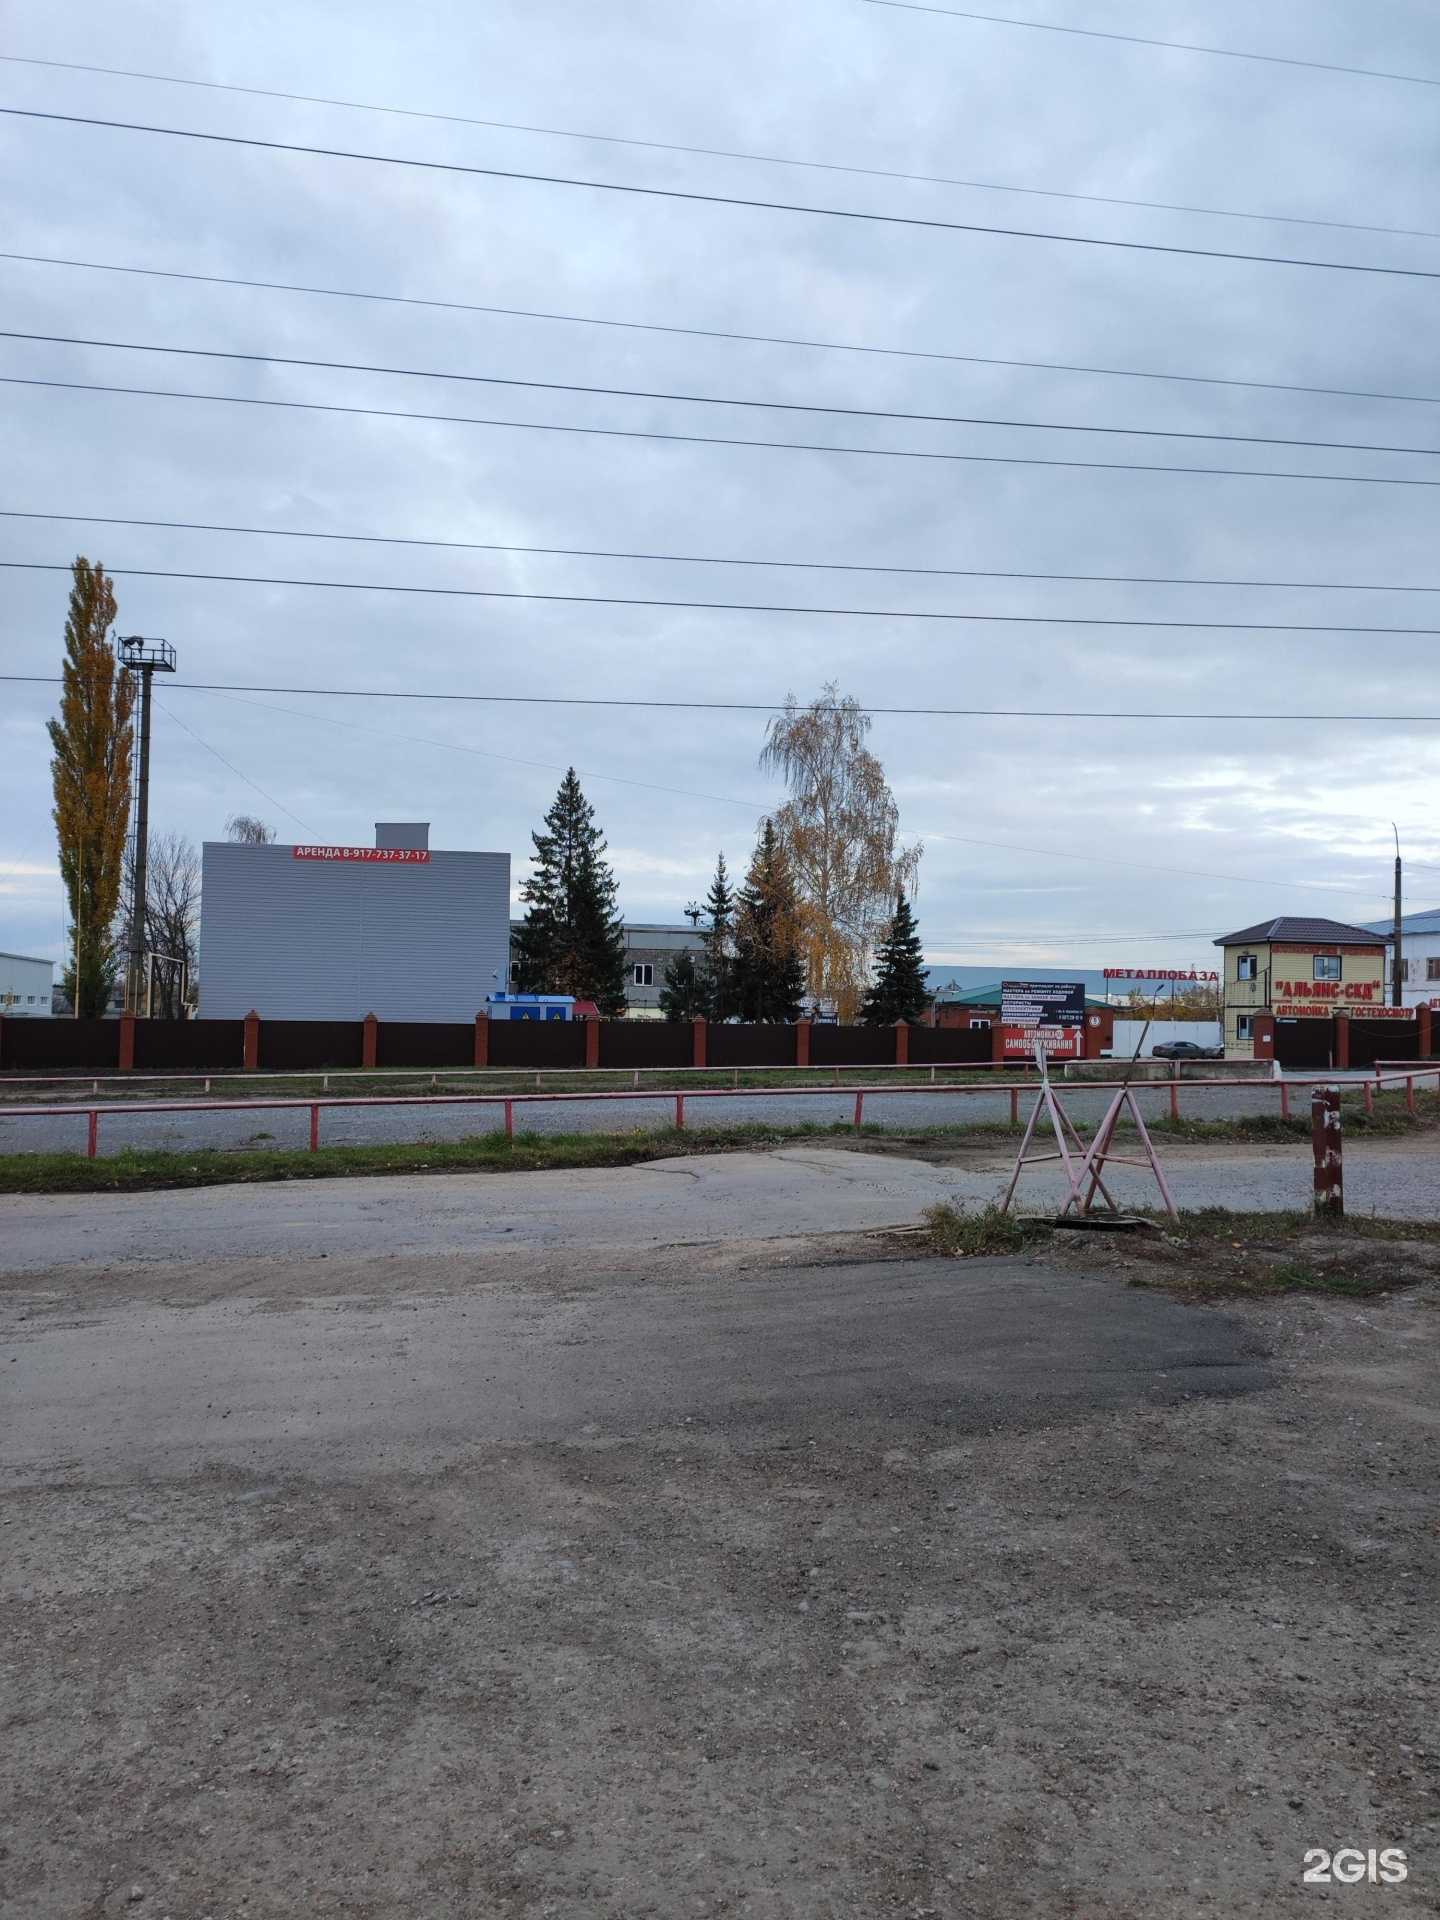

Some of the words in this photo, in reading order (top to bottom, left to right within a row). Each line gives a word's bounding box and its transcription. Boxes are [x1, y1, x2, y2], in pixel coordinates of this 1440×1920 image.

[296, 847, 340, 857] АРЕНДА
[343, 849, 427, 860] 8-917-737-37-17
[1103, 968, 1218, 981] МЕТАЛЛОБАЗА
[1276, 1005, 1330, 1017] АВТОМОЙКА
[1351, 1007, 1414, 1018] ГОСТЕХОСМОТР
[1024, 1030, 1055, 1039] АВТОМОЙКА
[1005, 1039, 1073, 1049] САМООБСУЖИВАНИЯ
